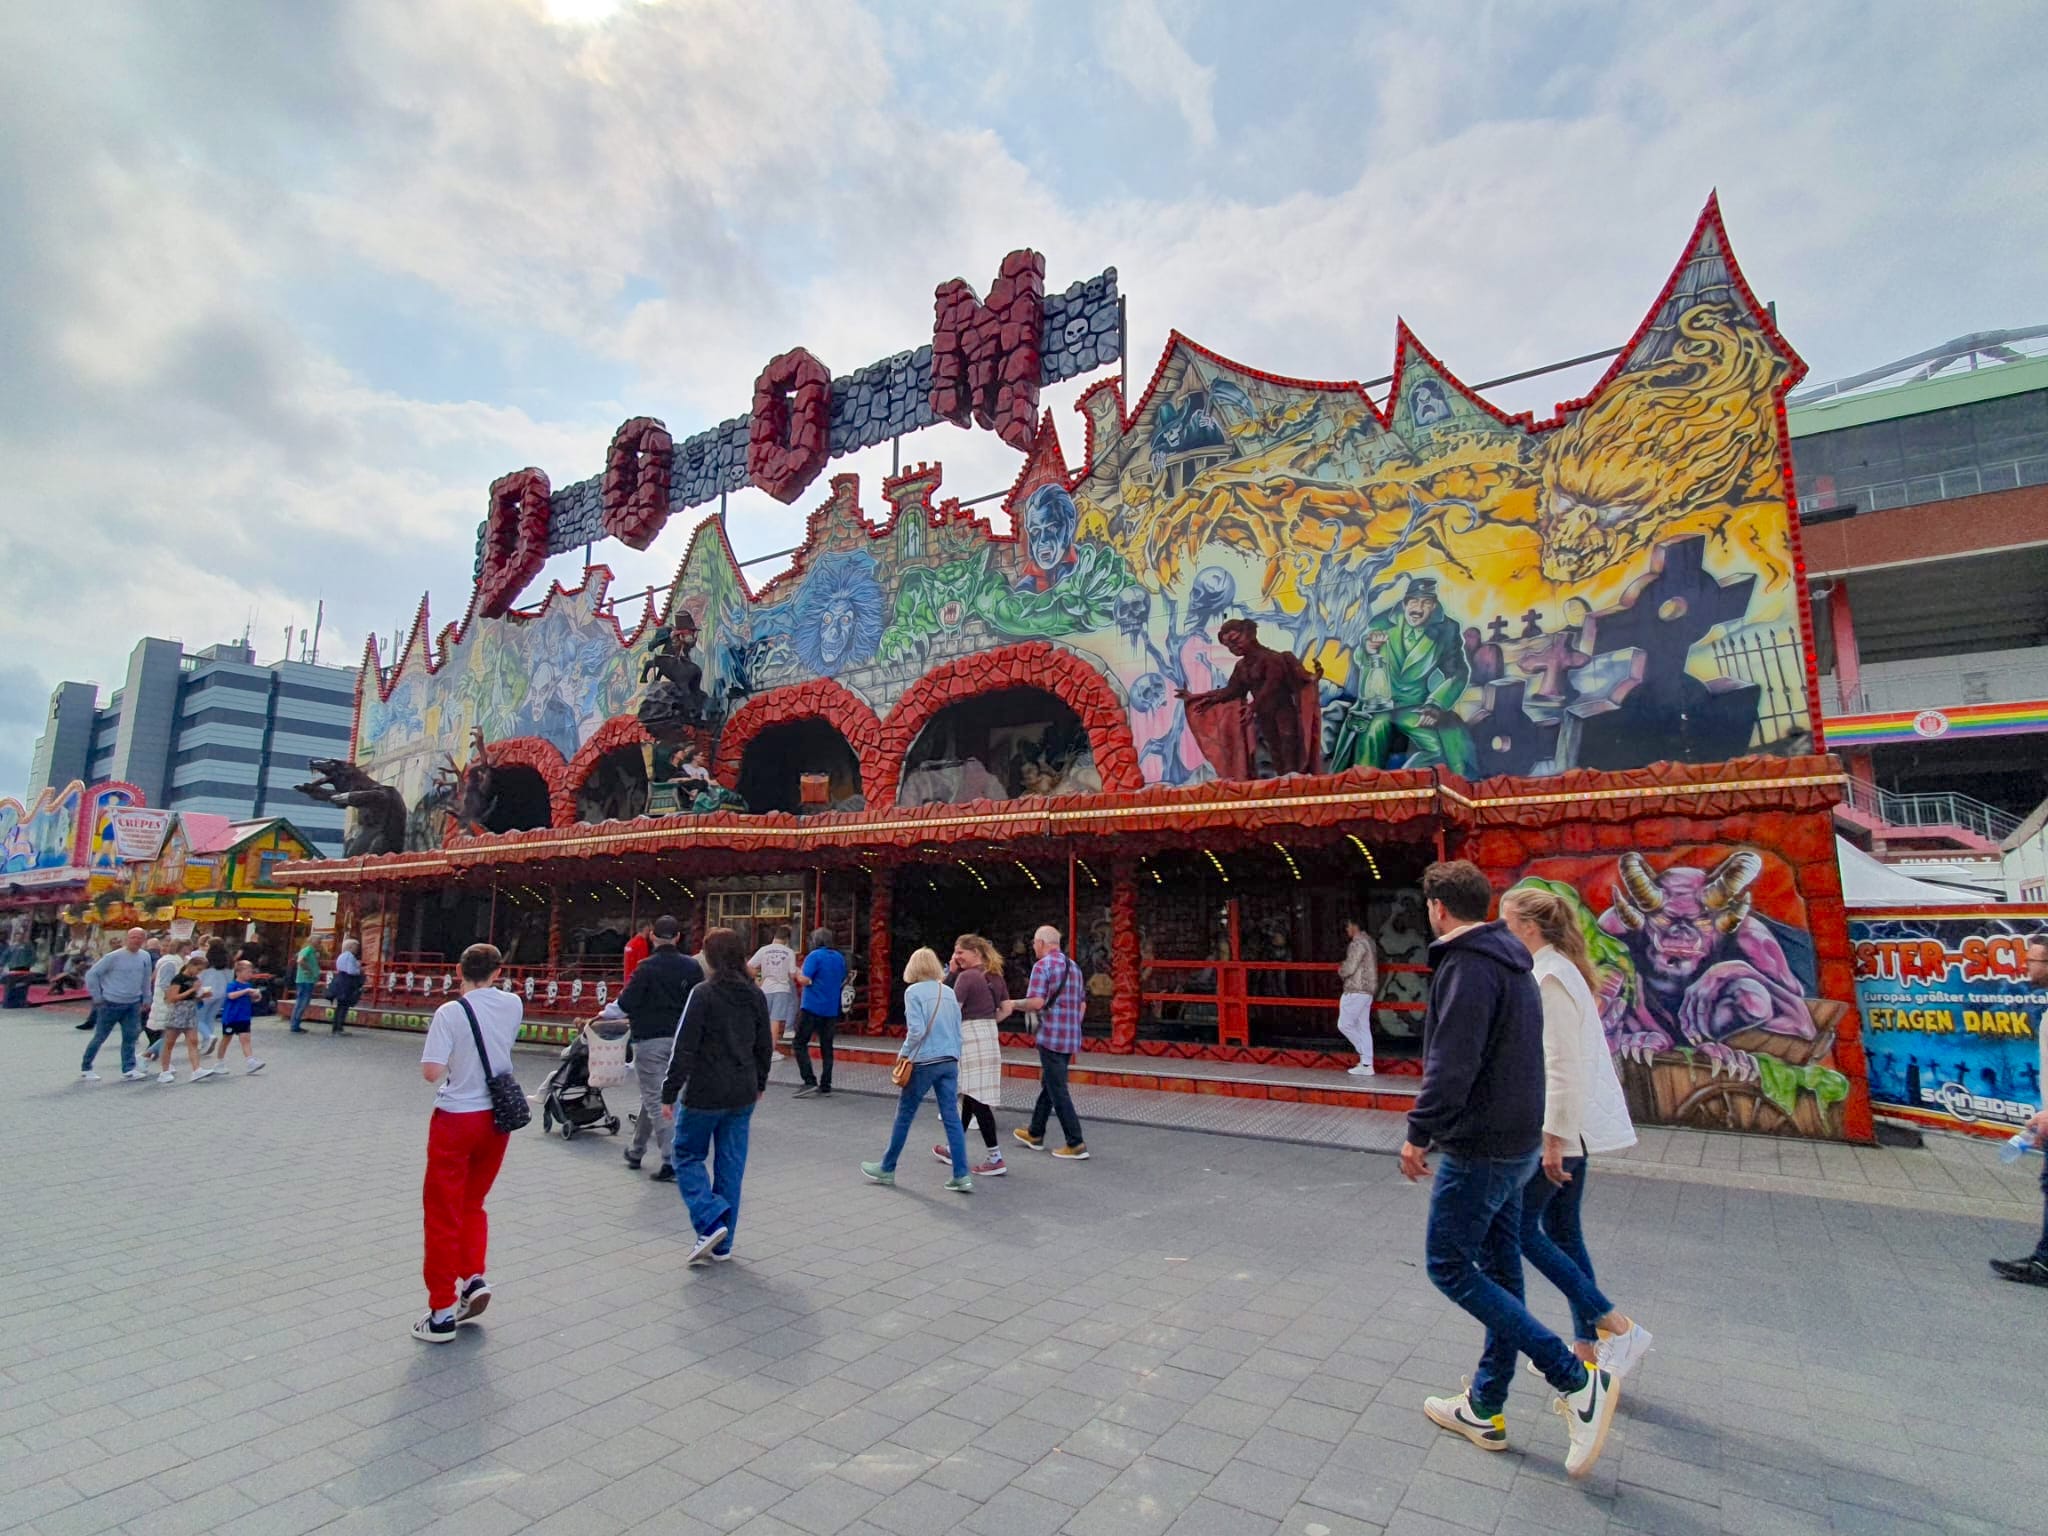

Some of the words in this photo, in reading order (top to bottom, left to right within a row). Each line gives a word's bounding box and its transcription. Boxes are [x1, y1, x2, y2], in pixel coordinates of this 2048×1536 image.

[1864, 991, 1912, 1003] Europas
[1915, 990, 1964, 1005] größter
[1869, 1009, 1954, 1033] ETAGEN
[1962, 1010, 2032, 1036] DARK
[1920, 1087, 2036, 1120] SCHNEIDER
